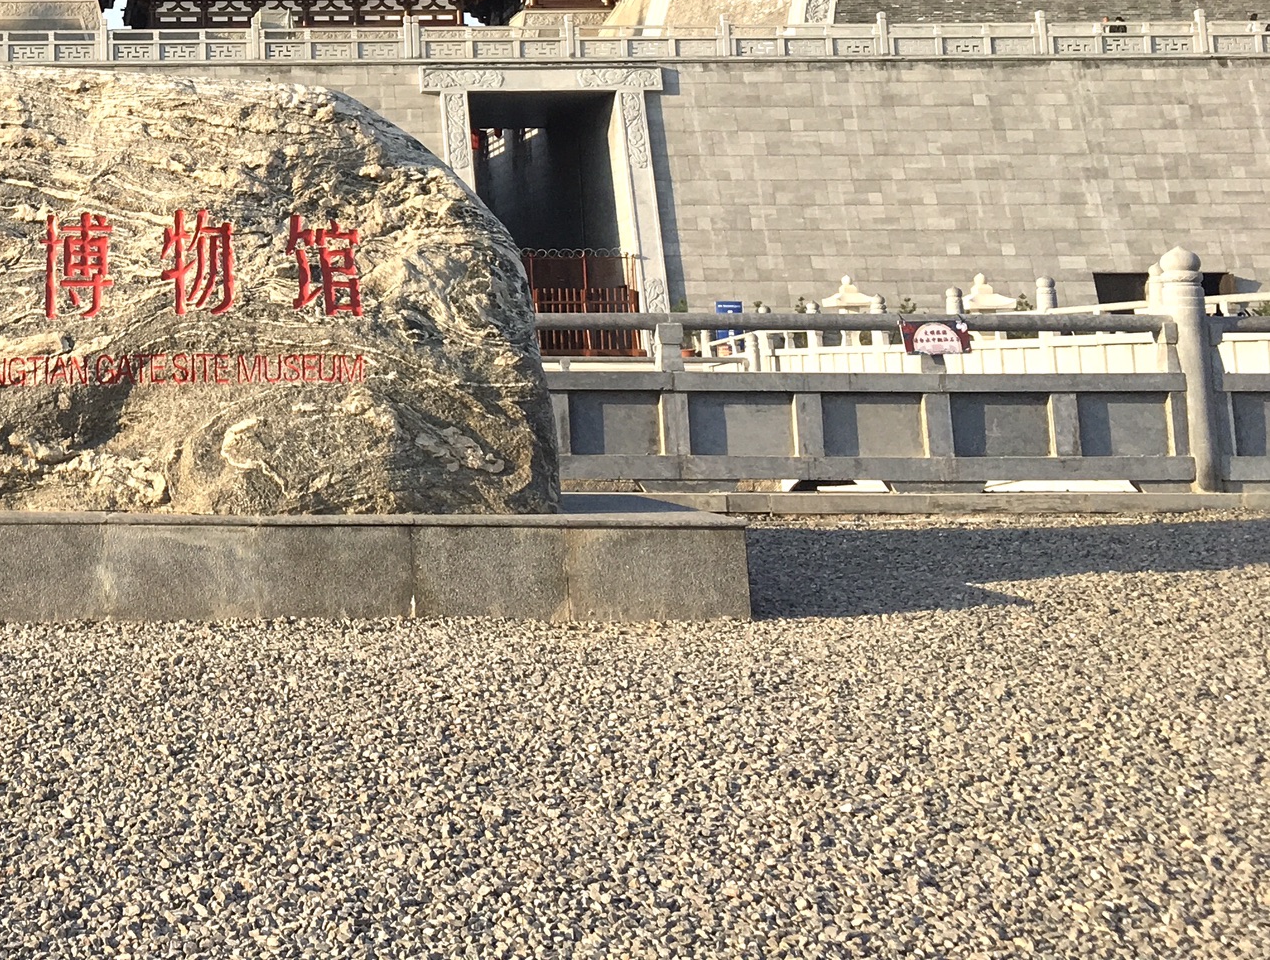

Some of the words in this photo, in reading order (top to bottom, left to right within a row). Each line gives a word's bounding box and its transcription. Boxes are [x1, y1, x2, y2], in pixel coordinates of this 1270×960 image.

[96, 352, 167, 385] GATE
[172, 353, 230, 385] SITE
[237, 353, 366, 385] MUSEUM
